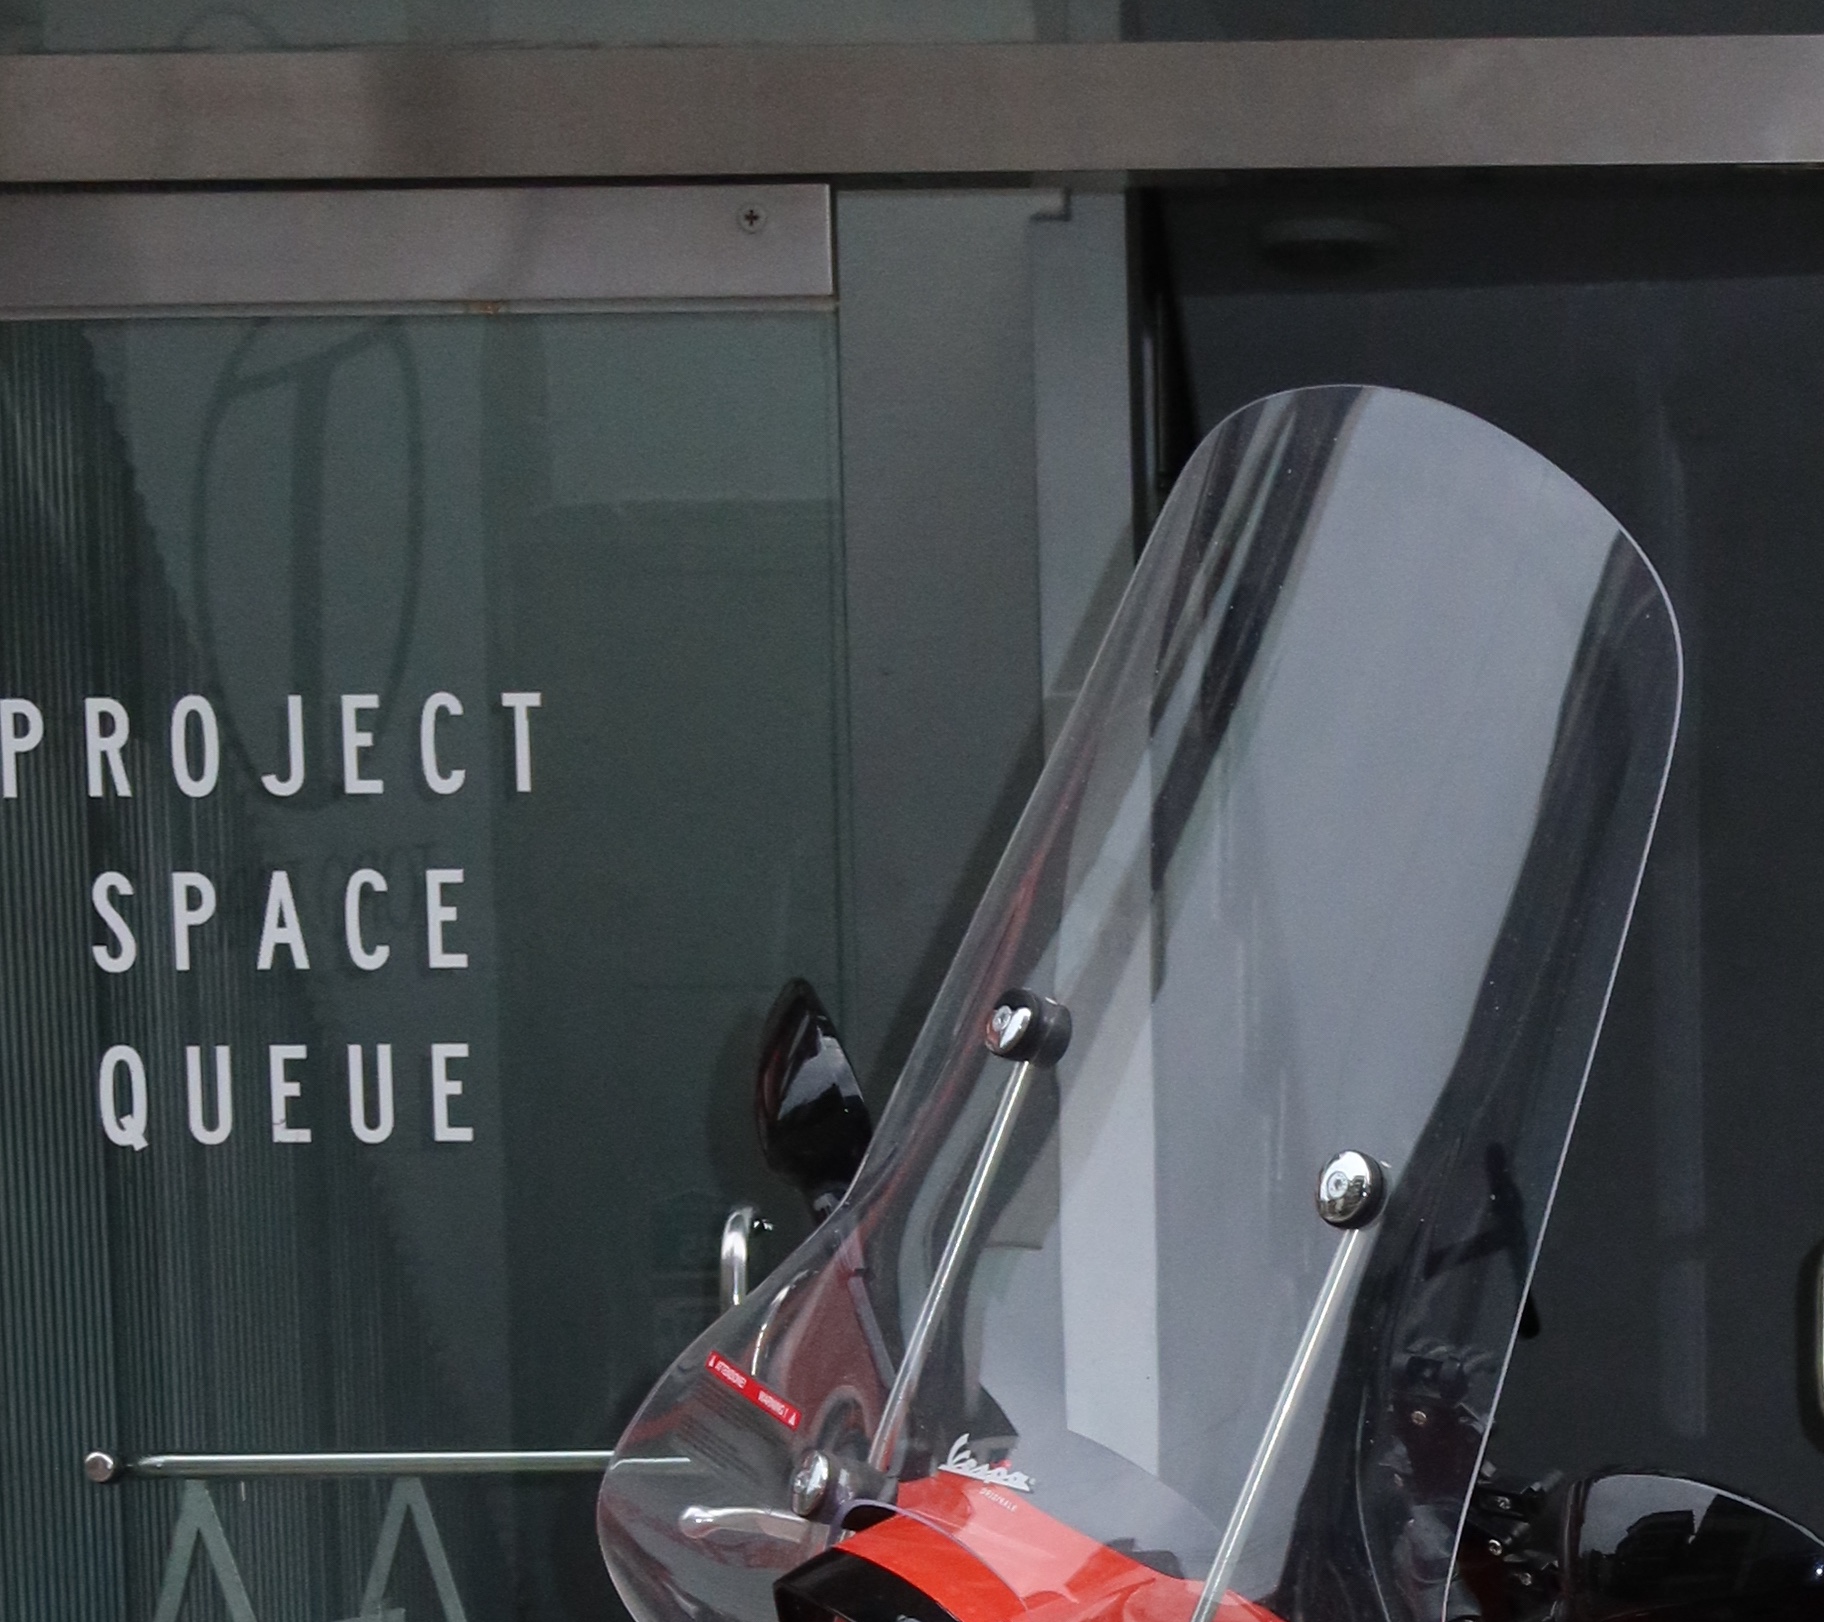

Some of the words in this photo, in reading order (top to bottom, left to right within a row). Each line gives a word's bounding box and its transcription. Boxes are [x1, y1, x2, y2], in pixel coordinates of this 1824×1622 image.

[0, 692, 542, 798] PROJECT
[91, 868, 470, 974] SPACE
[98, 1043, 474, 1151] QUEUE
[938, 1432, 1031, 1492] Vespa
